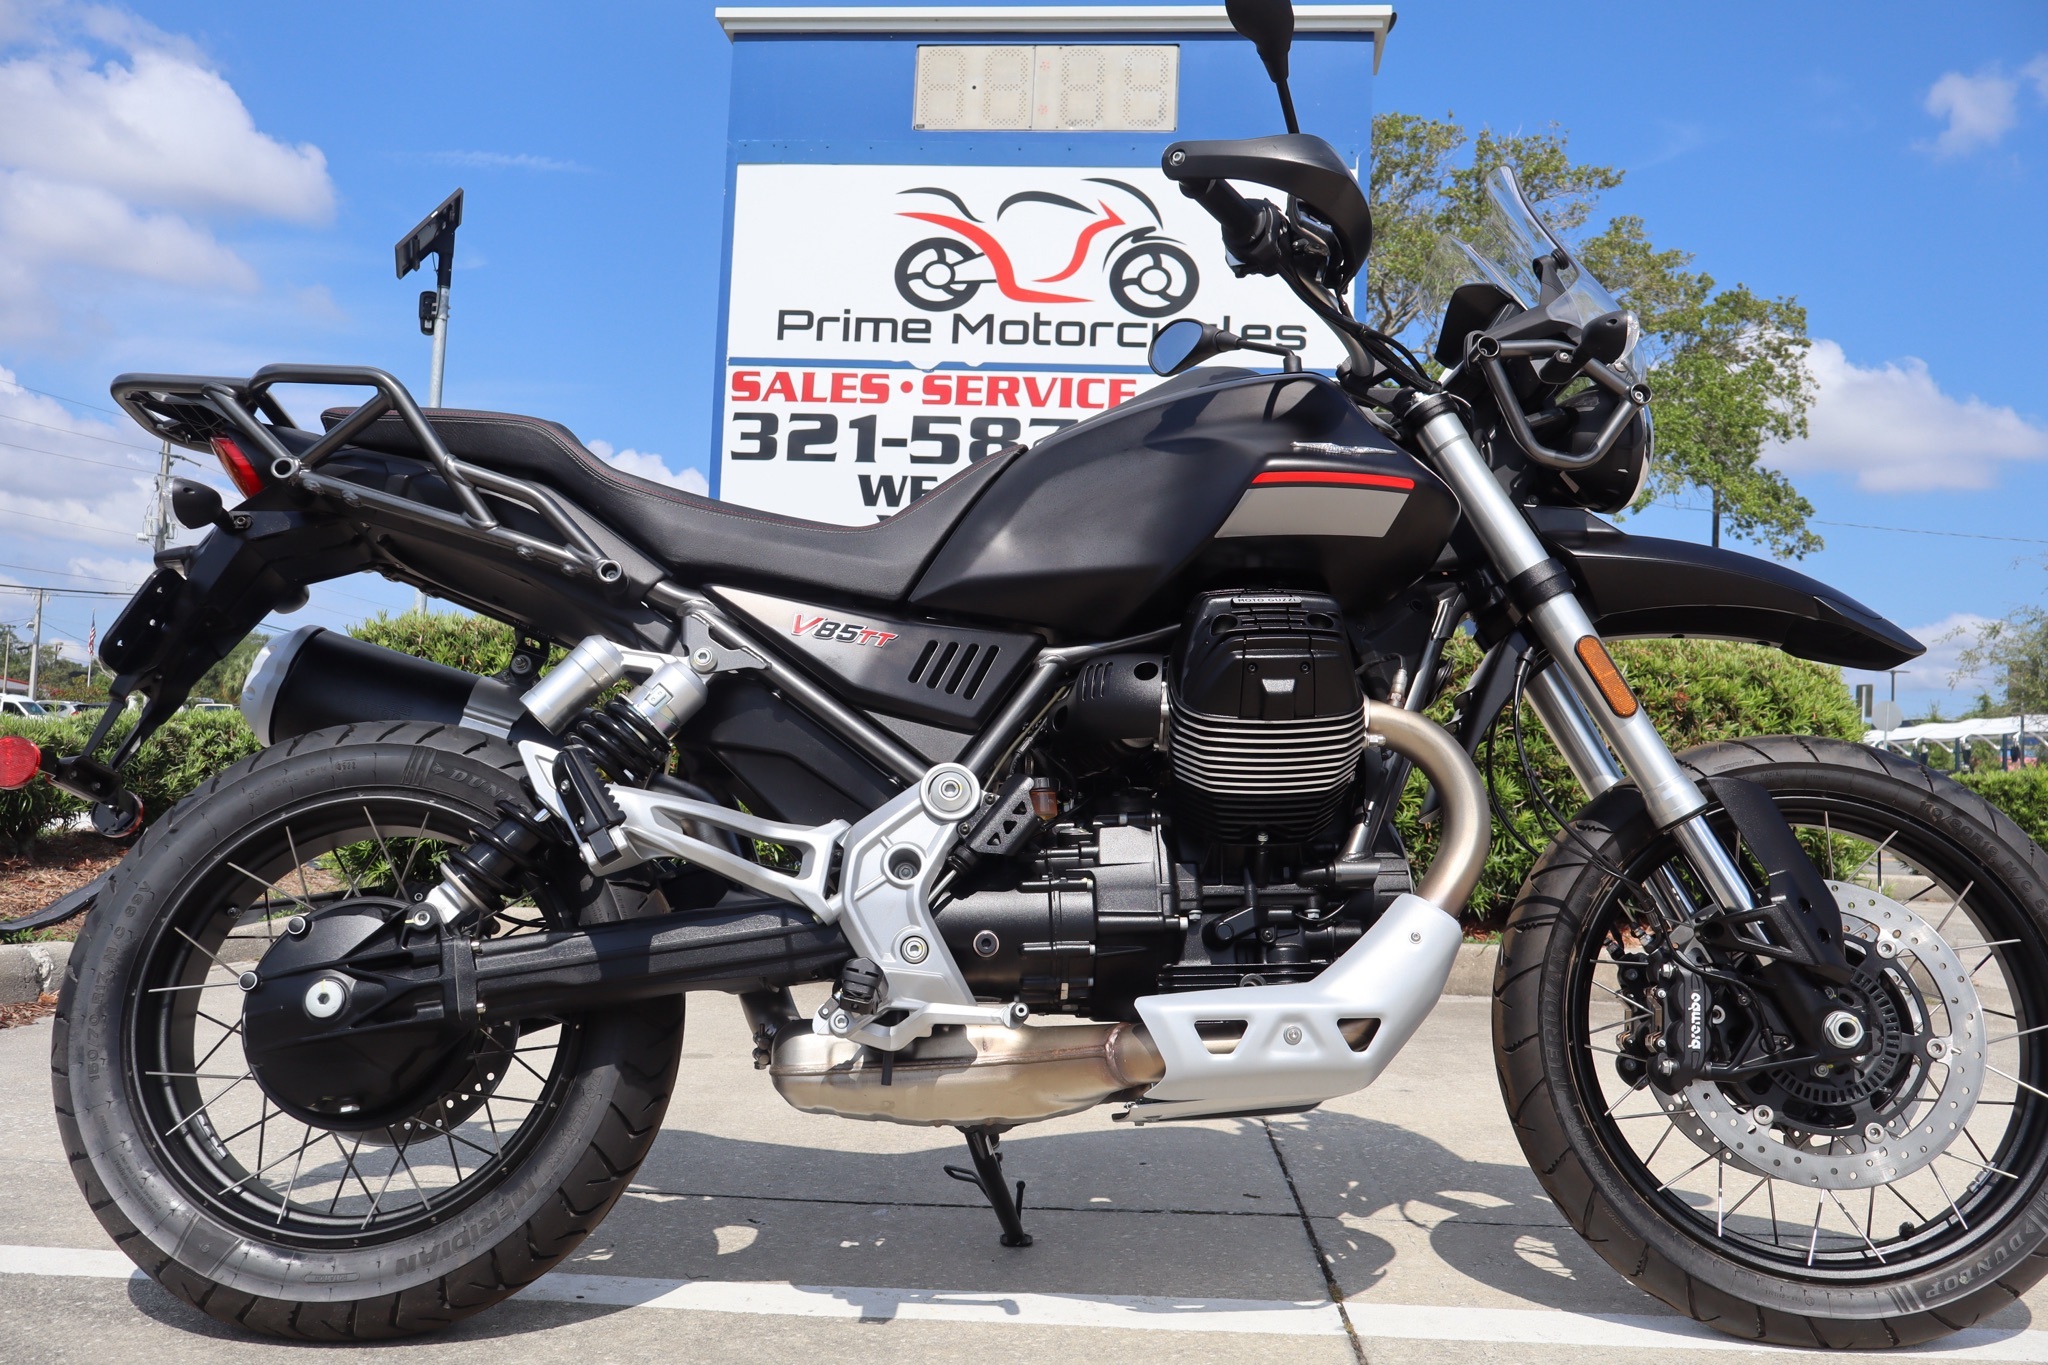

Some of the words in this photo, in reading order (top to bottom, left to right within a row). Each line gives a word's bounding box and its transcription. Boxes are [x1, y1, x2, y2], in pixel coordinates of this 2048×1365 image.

[777, 309, 932, 344] Prime
[952, 312, 1308, 350] Motorces
[732, 371, 890, 404] SALES
[922, 373, 1138, 409] SERVICE
[791, 614, 899, 648] V85TT
[448, 768, 532, 814] DUNL
[1543, 945, 1568, 1092] MERIDIAN
[1687, 992, 1701, 1050] brembo
[395, 1178, 538, 1277] MERIDIAN
[1925, 1233, 2025, 1299] DUNLOP
